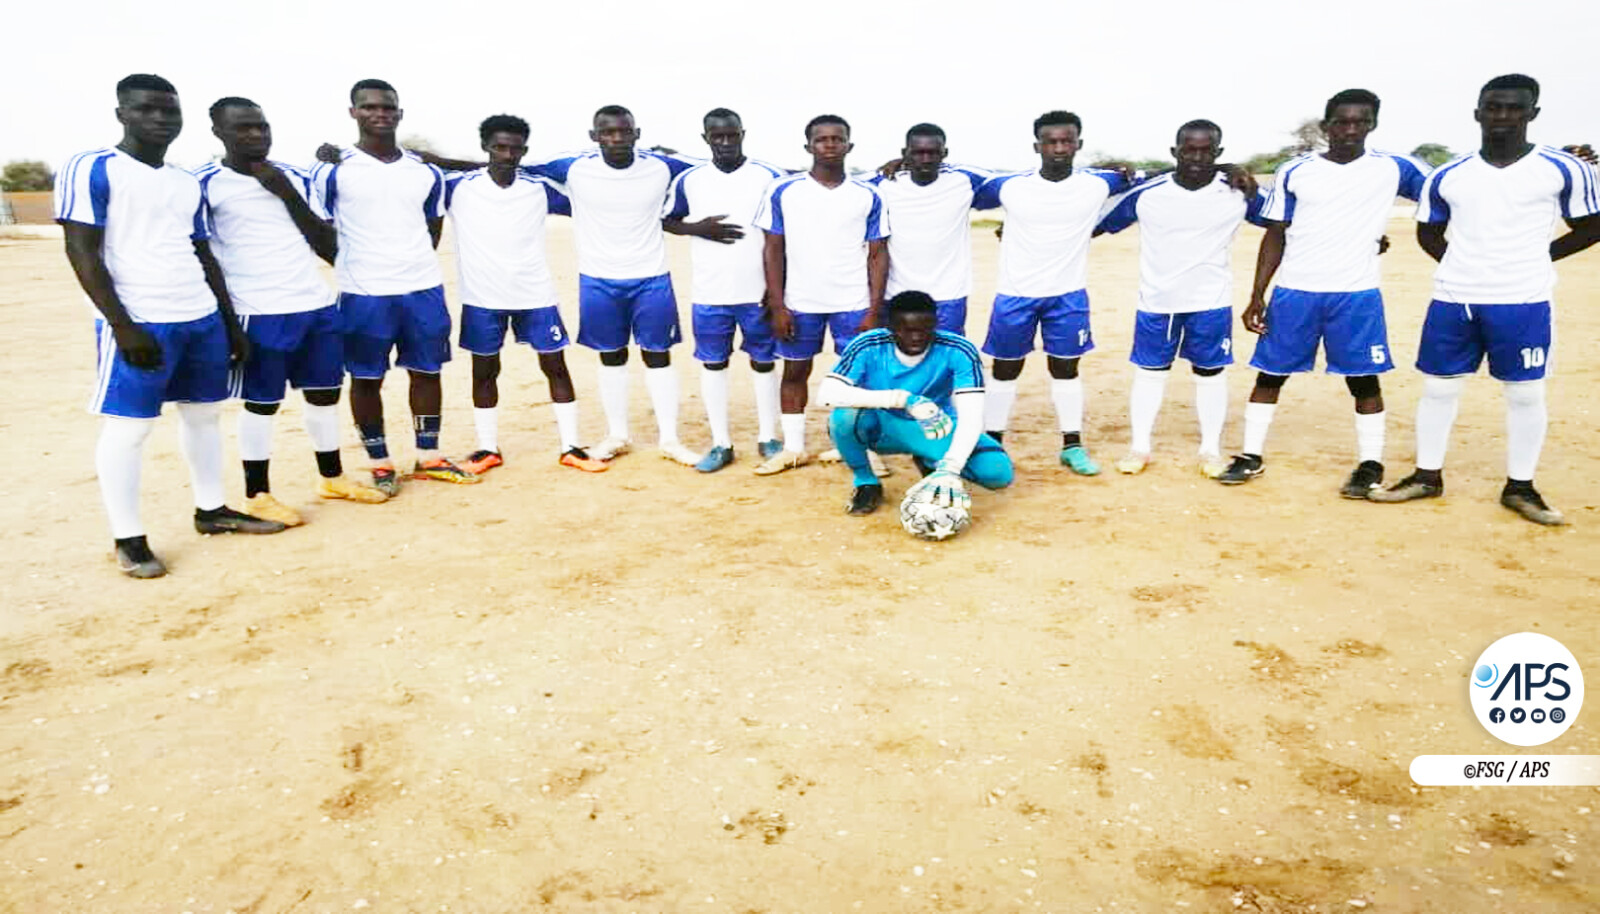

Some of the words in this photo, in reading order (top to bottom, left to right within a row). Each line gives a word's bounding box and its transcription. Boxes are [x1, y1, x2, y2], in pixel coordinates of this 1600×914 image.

[550, 325, 562, 341] 3
[1371, 345, 1385, 365] 5
[1521, 347, 1545, 369] 10
